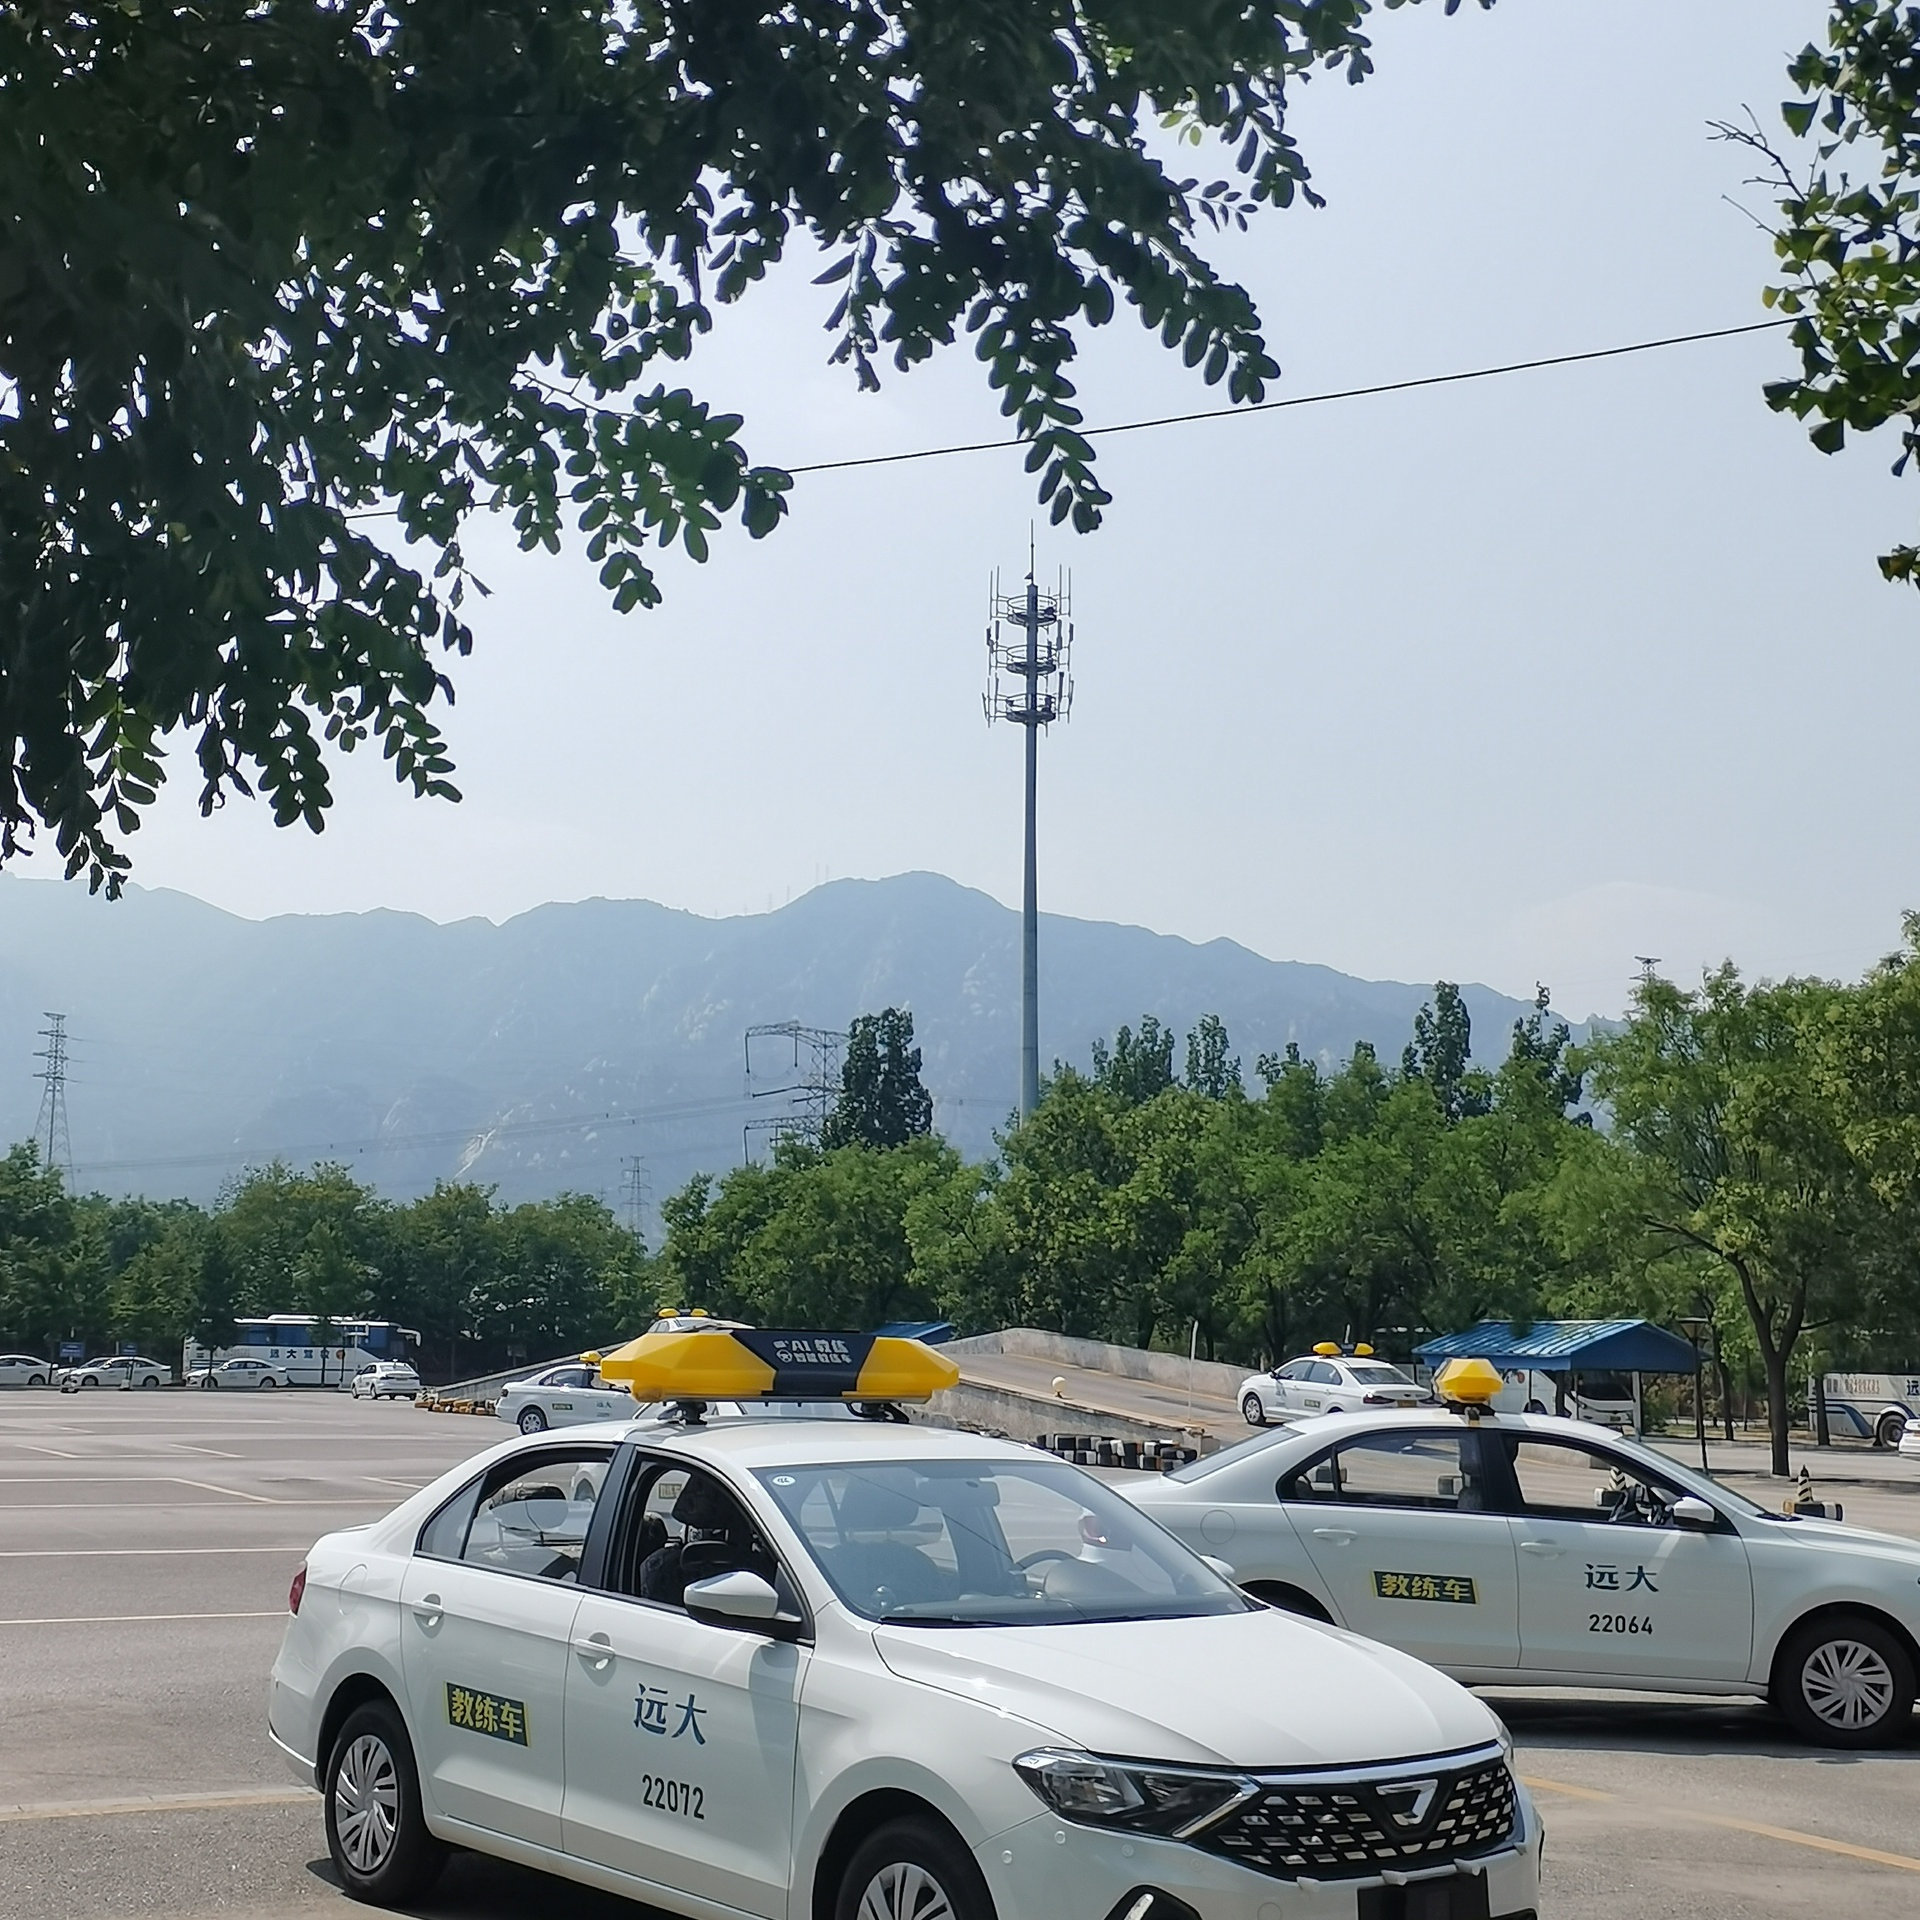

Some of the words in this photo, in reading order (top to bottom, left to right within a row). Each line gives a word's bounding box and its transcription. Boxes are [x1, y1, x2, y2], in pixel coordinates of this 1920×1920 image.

[1380, 1573, 1472, 1602] 教练车
[1584, 1563, 1659, 1593] 远大
[1588, 1613, 1653, 1635] 22064
[451, 1687, 523, 1739] 教练车
[633, 1682, 707, 1745] 远大
[642, 1774, 705, 1820] 22072
